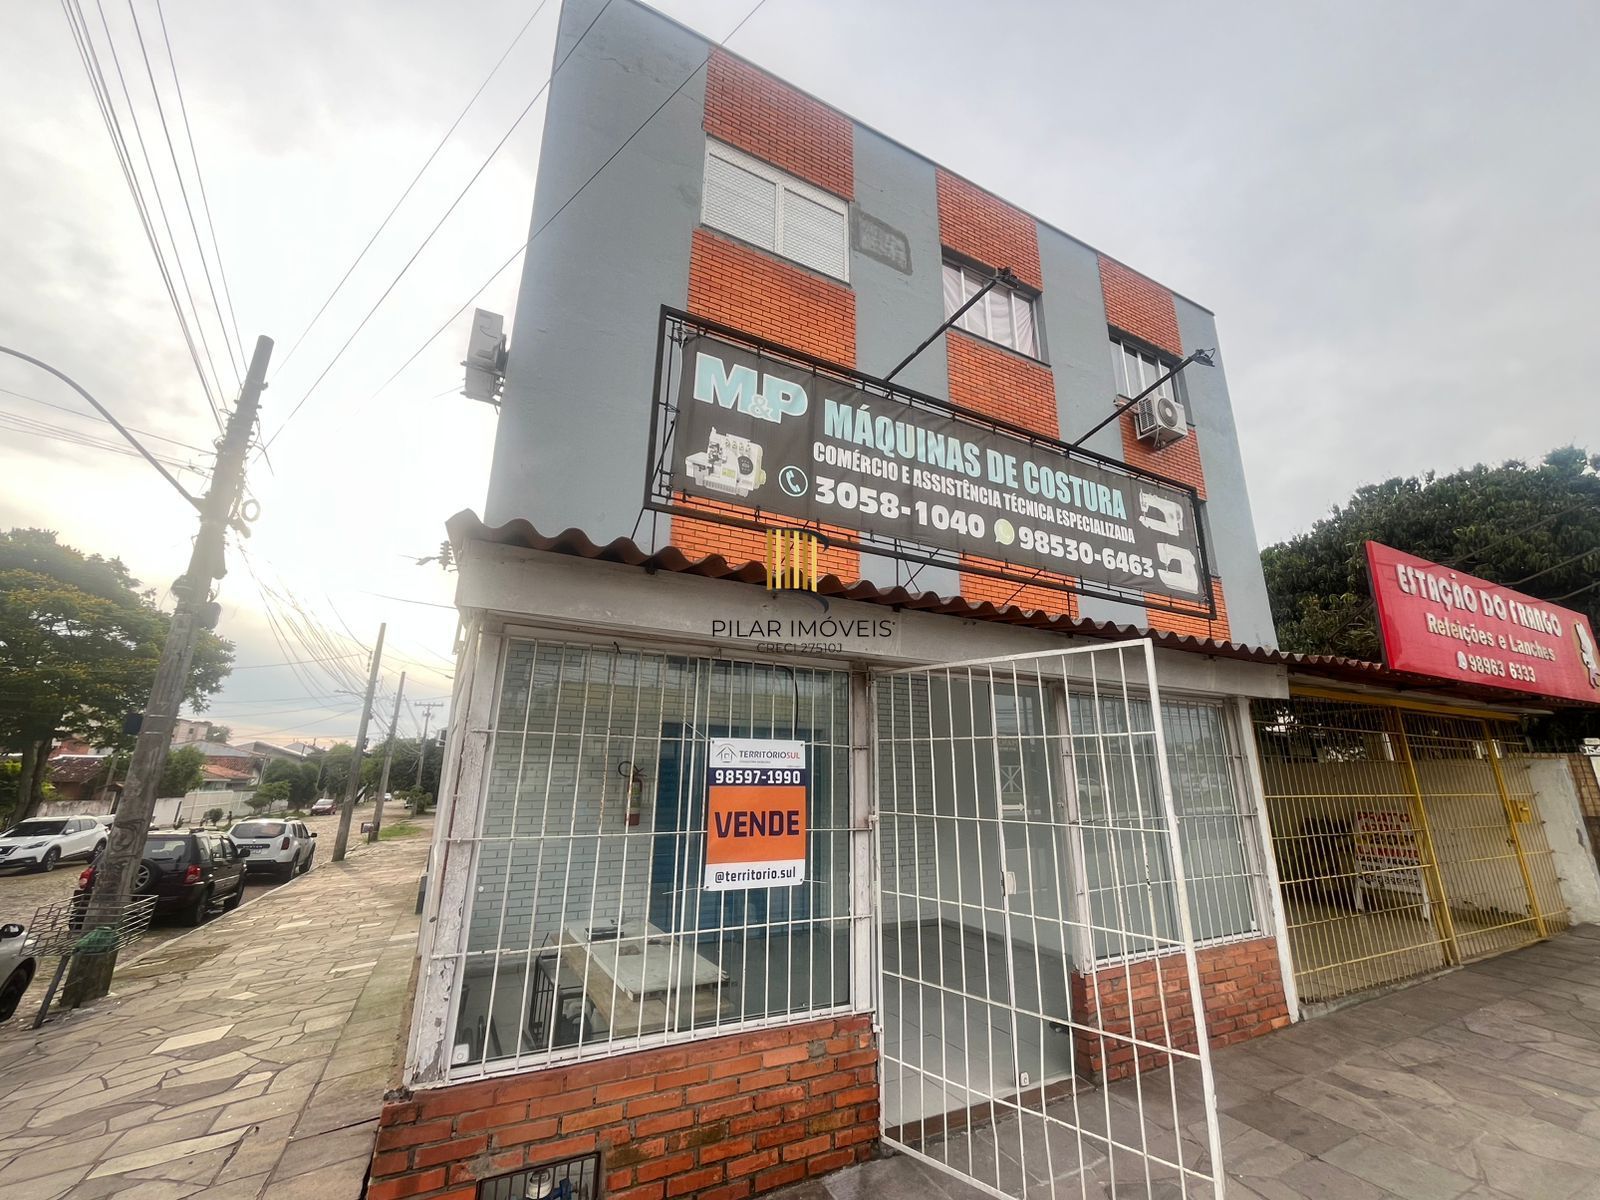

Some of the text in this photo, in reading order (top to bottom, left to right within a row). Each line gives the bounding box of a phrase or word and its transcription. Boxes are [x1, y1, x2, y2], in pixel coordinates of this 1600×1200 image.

[693, 351, 808, 424] M&P
[824, 398, 1127, 520] MÁQUINAS DE COSTURA
[813, 441, 1136, 544] COMÉRCIO E ASSISTÊNCIA TÉCNICA ESPECIALIZADA
[815, 475, 985, 538] 3058-1040
[1018, 526, 1155, 578] 98530-6463
[1395, 563, 1563, 637] ESTAÇÃO DO FRANGO
[1425, 613, 1556, 661] Refeições e Lanches
[1467, 654, 1536, 682] 98963 6333
[715, 770, 801, 784] 98597-1990
[714, 810, 800, 838] VENDE
[715, 866, 796, 883] @territorio.sul
